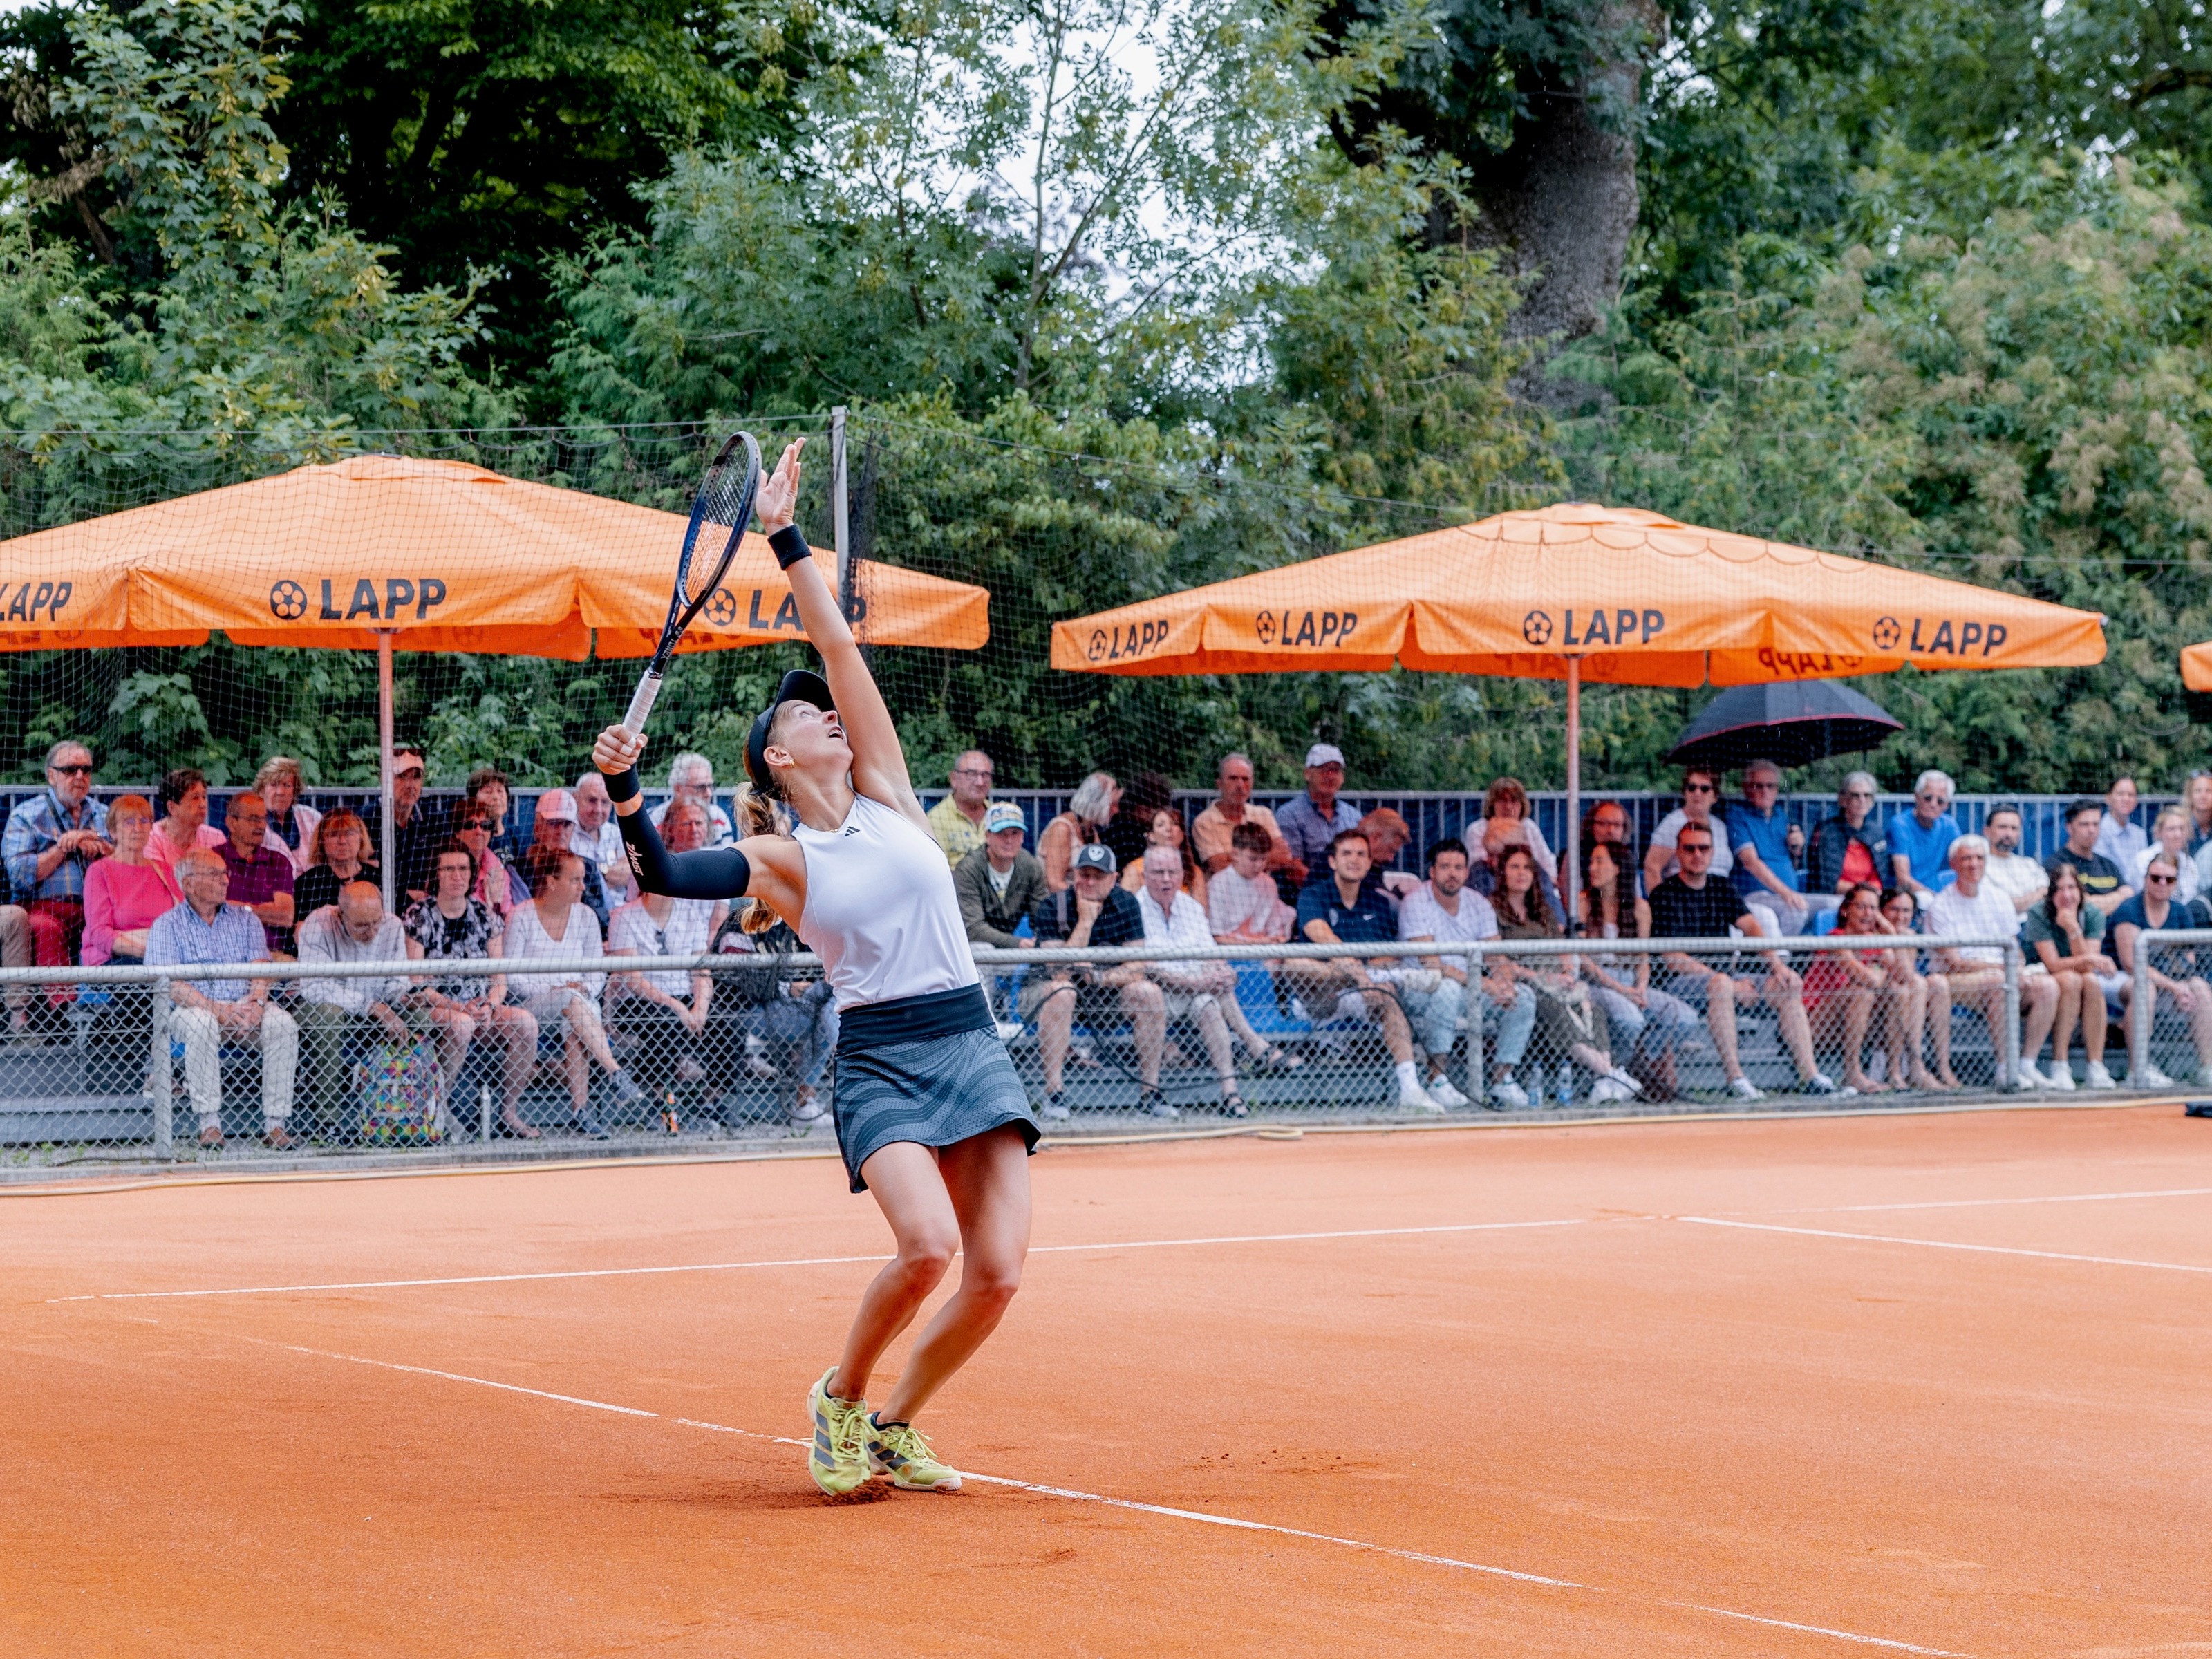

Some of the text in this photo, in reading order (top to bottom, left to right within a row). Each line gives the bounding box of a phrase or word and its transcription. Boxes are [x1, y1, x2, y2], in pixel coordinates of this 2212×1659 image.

[320, 579, 447, 619] LAPP
[749, 590, 867, 631] LAP
[1109, 620, 1169, 659] LAPP
[1281, 610, 1358, 647] LAPP
[1564, 610, 1665, 645] LAPP
[1910, 619, 2007, 656] LAPP
[625, 841, 644, 876] ZAMST
